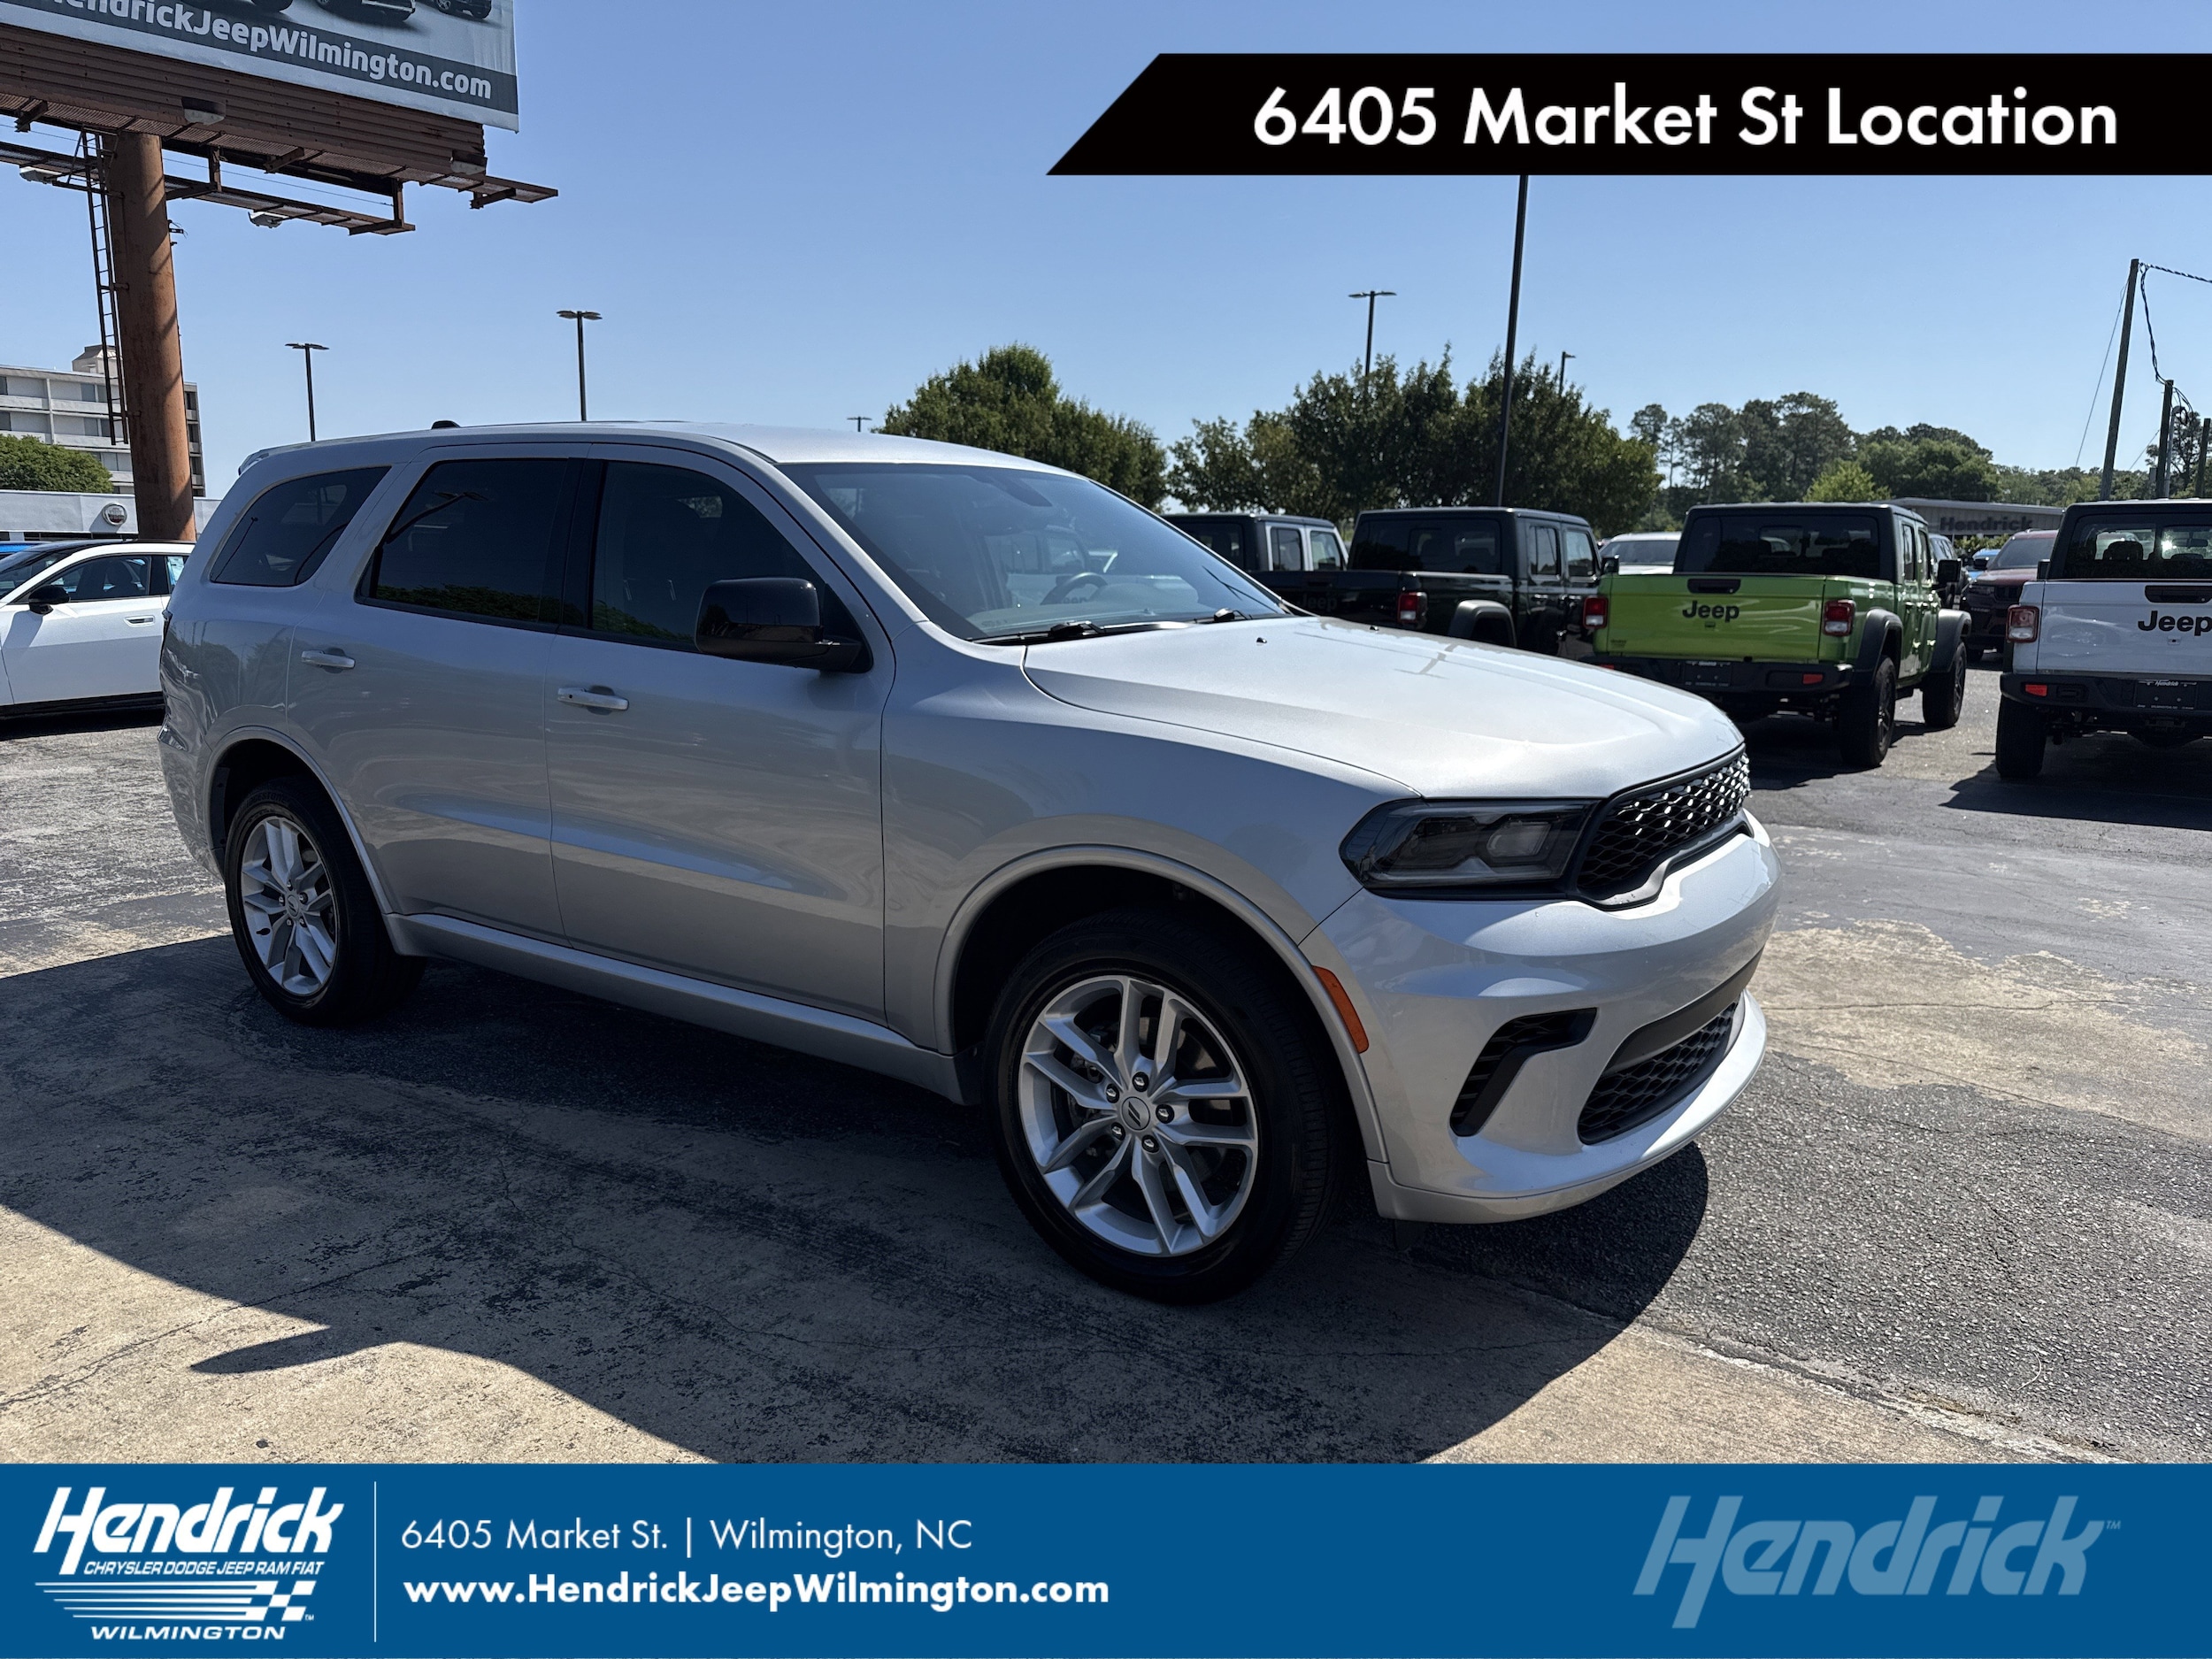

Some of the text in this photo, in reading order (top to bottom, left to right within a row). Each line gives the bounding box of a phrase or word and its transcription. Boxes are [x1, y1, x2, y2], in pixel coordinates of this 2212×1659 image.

[53, 0, 492, 99] ndrickJeepWilmington.com
[1939, 516, 2033, 531] Hendrick
[1297, 593, 1338, 612] Jeep
[1682, 600, 1740, 623] Jeep
[2138, 610, 2212, 636] Jeep
